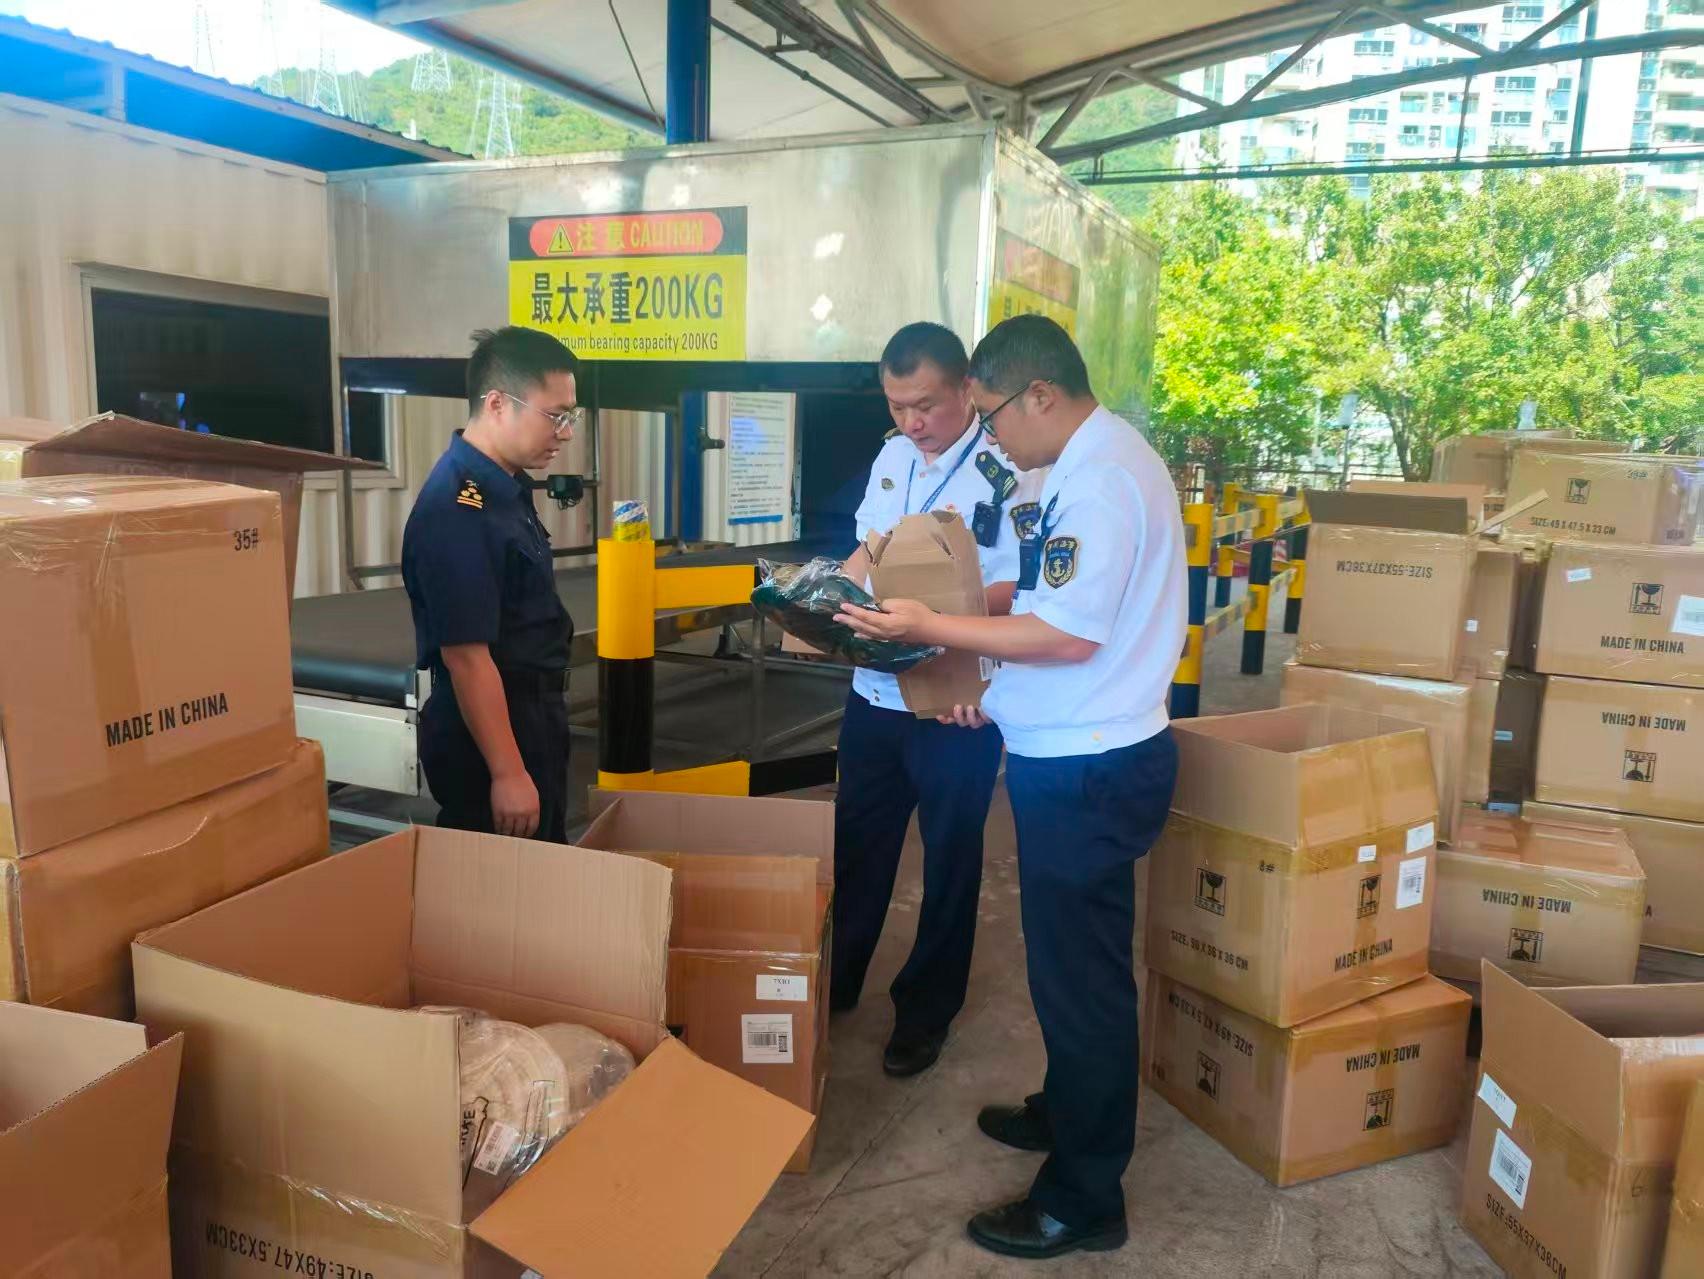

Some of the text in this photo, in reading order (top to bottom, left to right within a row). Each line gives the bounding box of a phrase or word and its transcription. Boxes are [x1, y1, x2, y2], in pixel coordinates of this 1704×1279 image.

[531, 271, 724, 324] 最大承重200KG
[589, 331, 630, 353] bearing
[632, 332, 679, 353] capacity
[681, 332, 719, 351] 200KG
[233, 527, 259, 551] 35#
[1600, 635, 1685, 654] MADE IN CHINA
[105, 693, 229, 747] MADE IN CHINA
[1602, 711, 1686, 732] MADE IN CHINA
[1482, 888, 1572, 913] MADE IN CHINA
[1335, 938, 1393, 972] MADE IN CHINA
[1346, 1043, 1421, 1073] MADE IN CHINA
